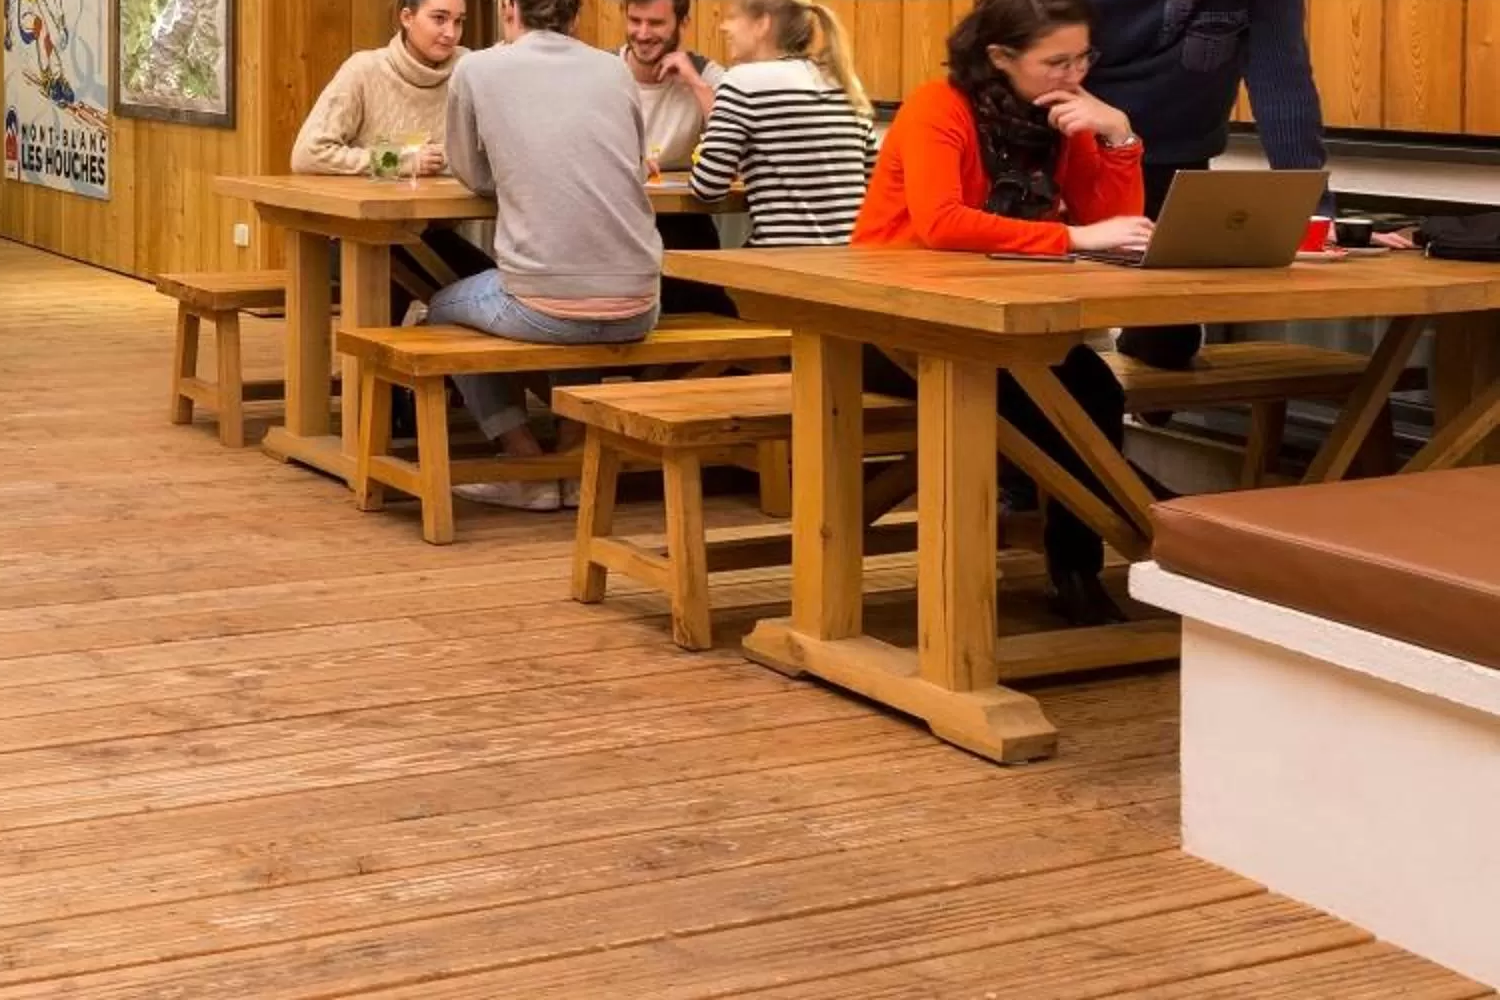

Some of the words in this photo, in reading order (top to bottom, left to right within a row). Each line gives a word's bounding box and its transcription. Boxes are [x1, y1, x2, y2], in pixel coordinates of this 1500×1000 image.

[21, 123, 106, 153] MONT-BLANC
[21, 144, 43, 172] LES
[45, 147, 106, 186] HOUCHES
